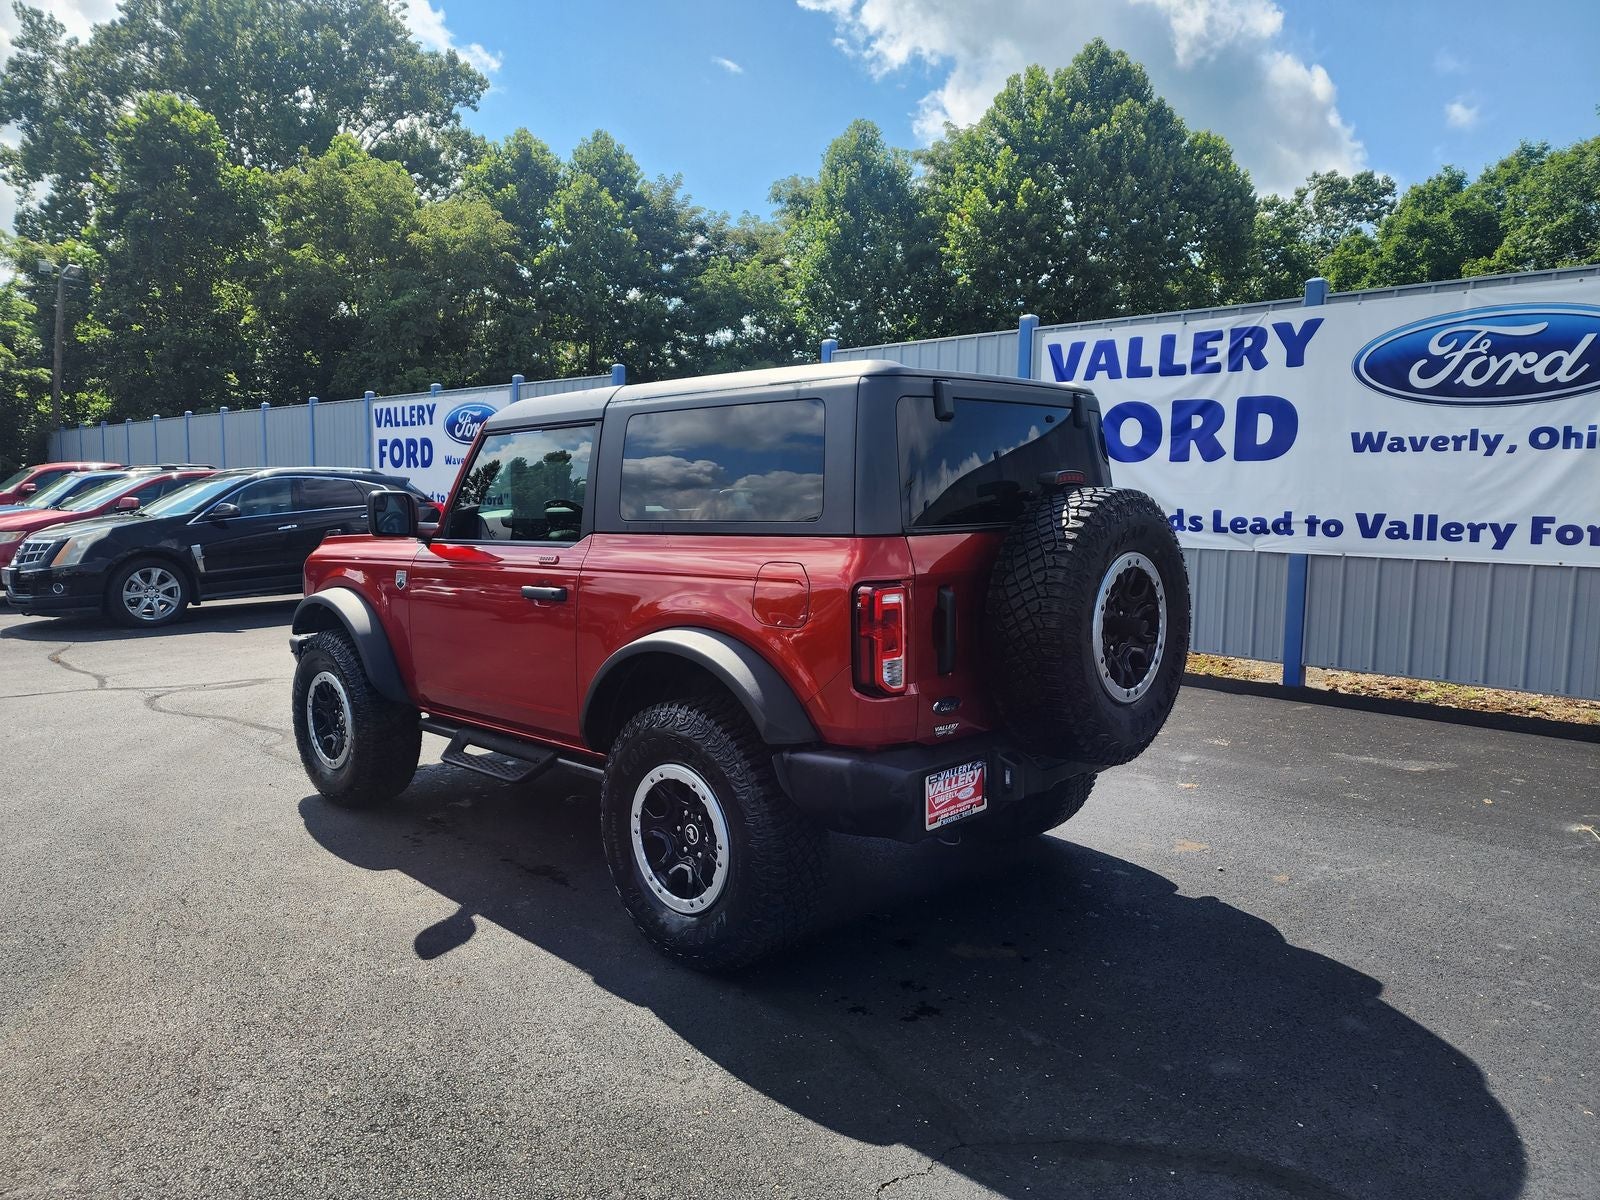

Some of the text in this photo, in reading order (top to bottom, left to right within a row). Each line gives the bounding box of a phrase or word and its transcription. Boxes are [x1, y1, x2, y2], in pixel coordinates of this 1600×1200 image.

[1048, 317, 1325, 382] VALLERY
[1408, 321, 1598, 389] Ford
[374, 403, 437, 428] VALLERY
[454, 410, 481, 438] For
[1102, 395, 1299, 463] ORD
[378, 437, 434, 469] FORD
[1350, 424, 1600, 457] Waverly, Ohi
[444, 455, 465, 465] Wave
[1213, 509, 1294, 536] Lead
[1304, 514, 1344, 538] to
[1355, 512, 1518, 550] Vallery
[1530, 516, 1600, 546] For
[935, 722, 960, 732] VALLERY
[929, 768, 982, 796] VALLERY
[939, 763, 972, 780] VALLERY
